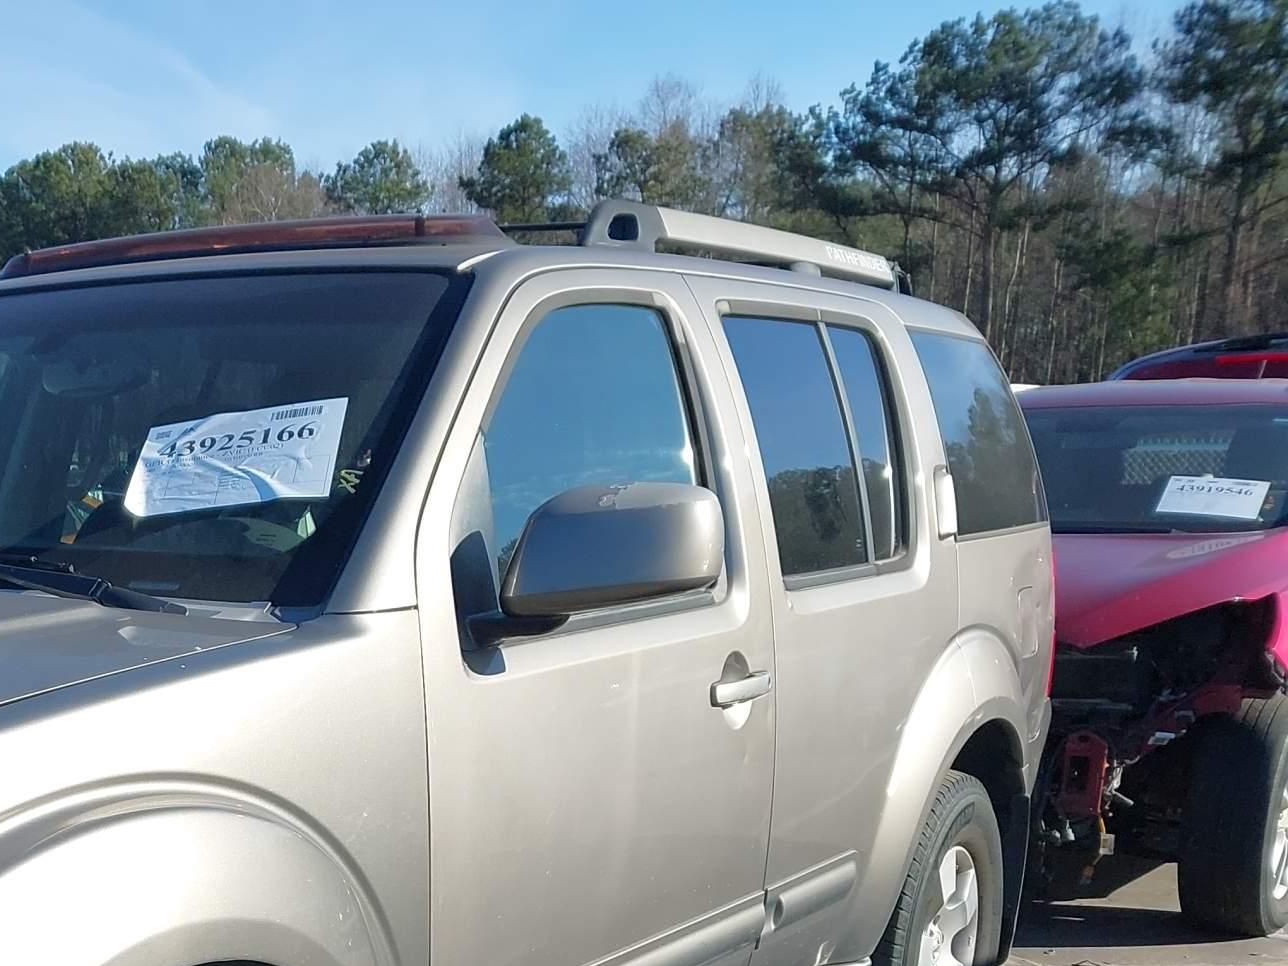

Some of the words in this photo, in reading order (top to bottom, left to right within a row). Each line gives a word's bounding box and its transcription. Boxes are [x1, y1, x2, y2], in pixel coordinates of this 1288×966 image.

[824, 245, 890, 273] PATHFINDER
[157, 420, 319, 459] 43925166
[1176, 483, 1254, 497] 43919546
